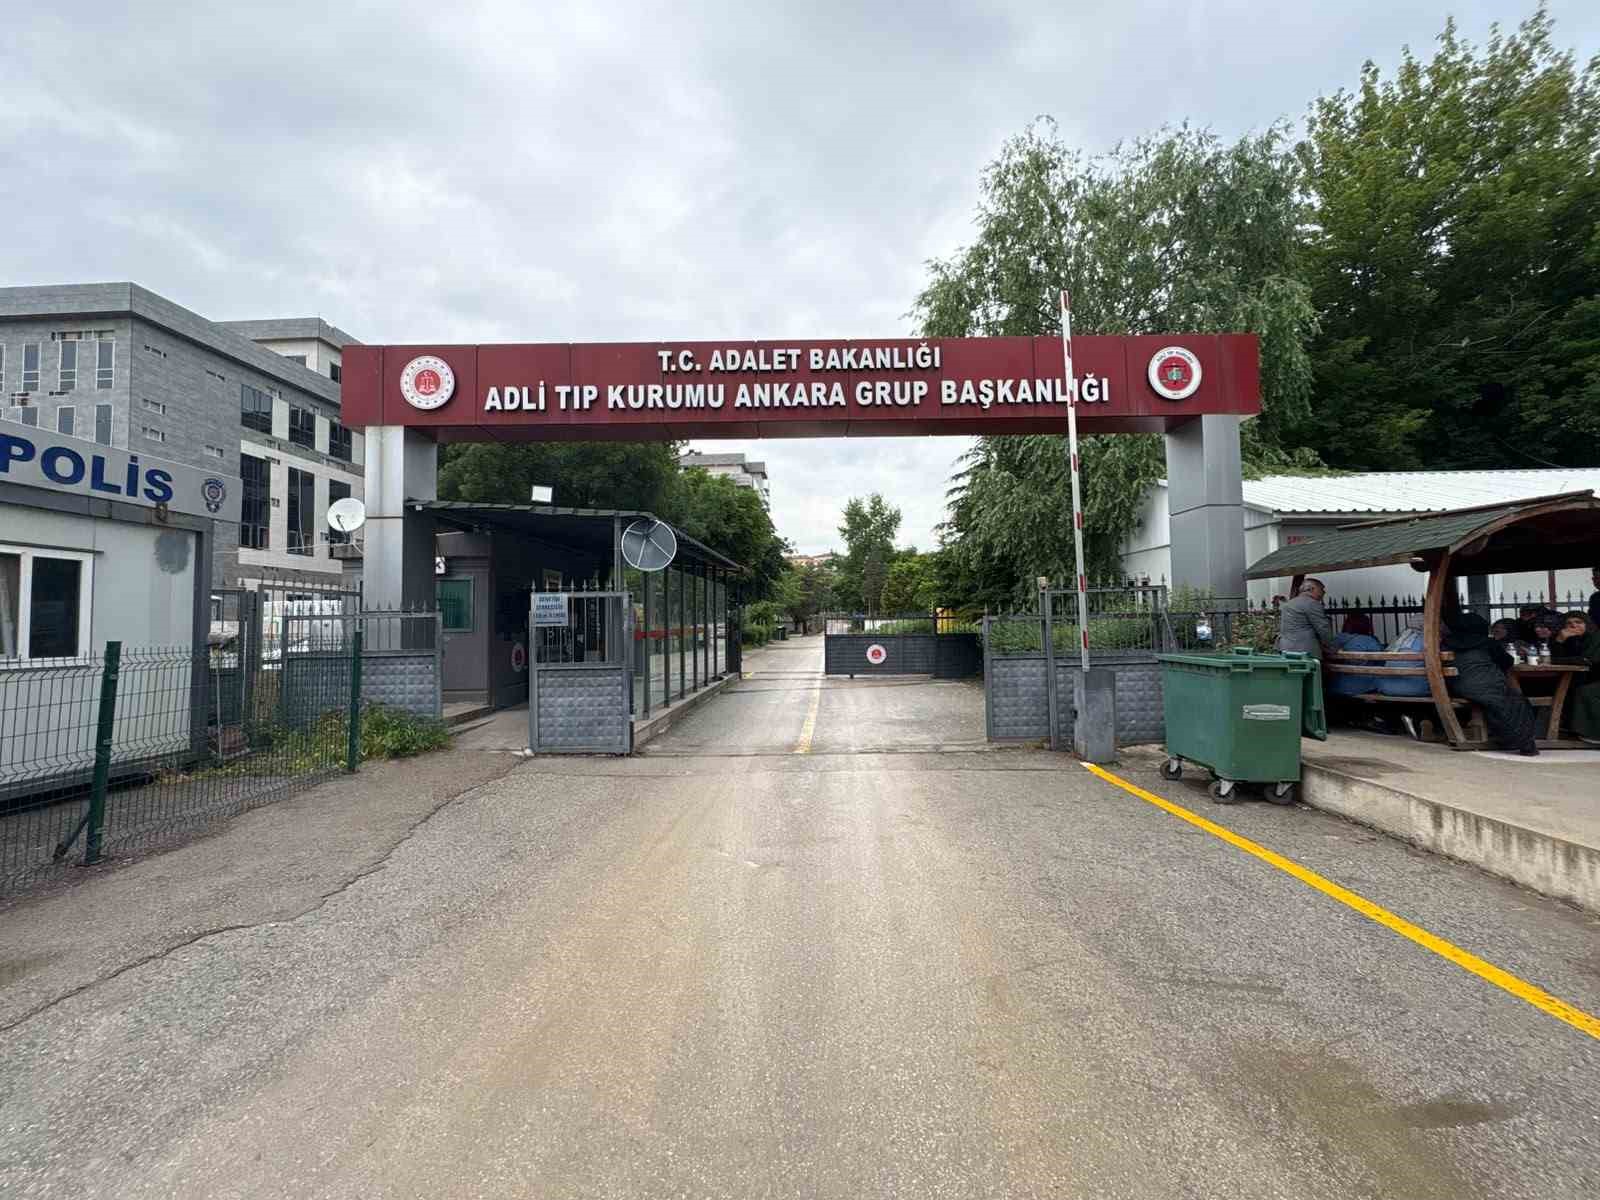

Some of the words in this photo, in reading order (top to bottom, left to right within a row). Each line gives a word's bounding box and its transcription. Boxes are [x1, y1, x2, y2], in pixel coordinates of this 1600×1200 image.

[658, 350, 702, 372] T.C.
[709, 348, 800, 371] ADALET
[809, 342, 941, 369] BAKANLIĞI
[484, 381, 545, 411] ADLİ
[555, 385, 598, 410] TIP
[606, 383, 724, 409] KURUMU
[734, 380, 846, 408] ANKARA
[855, 381, 929, 406] GRUP
[941, 373, 1109, 409] BAŞKANLIĞI
[0, 434, 173, 503] POLİS
